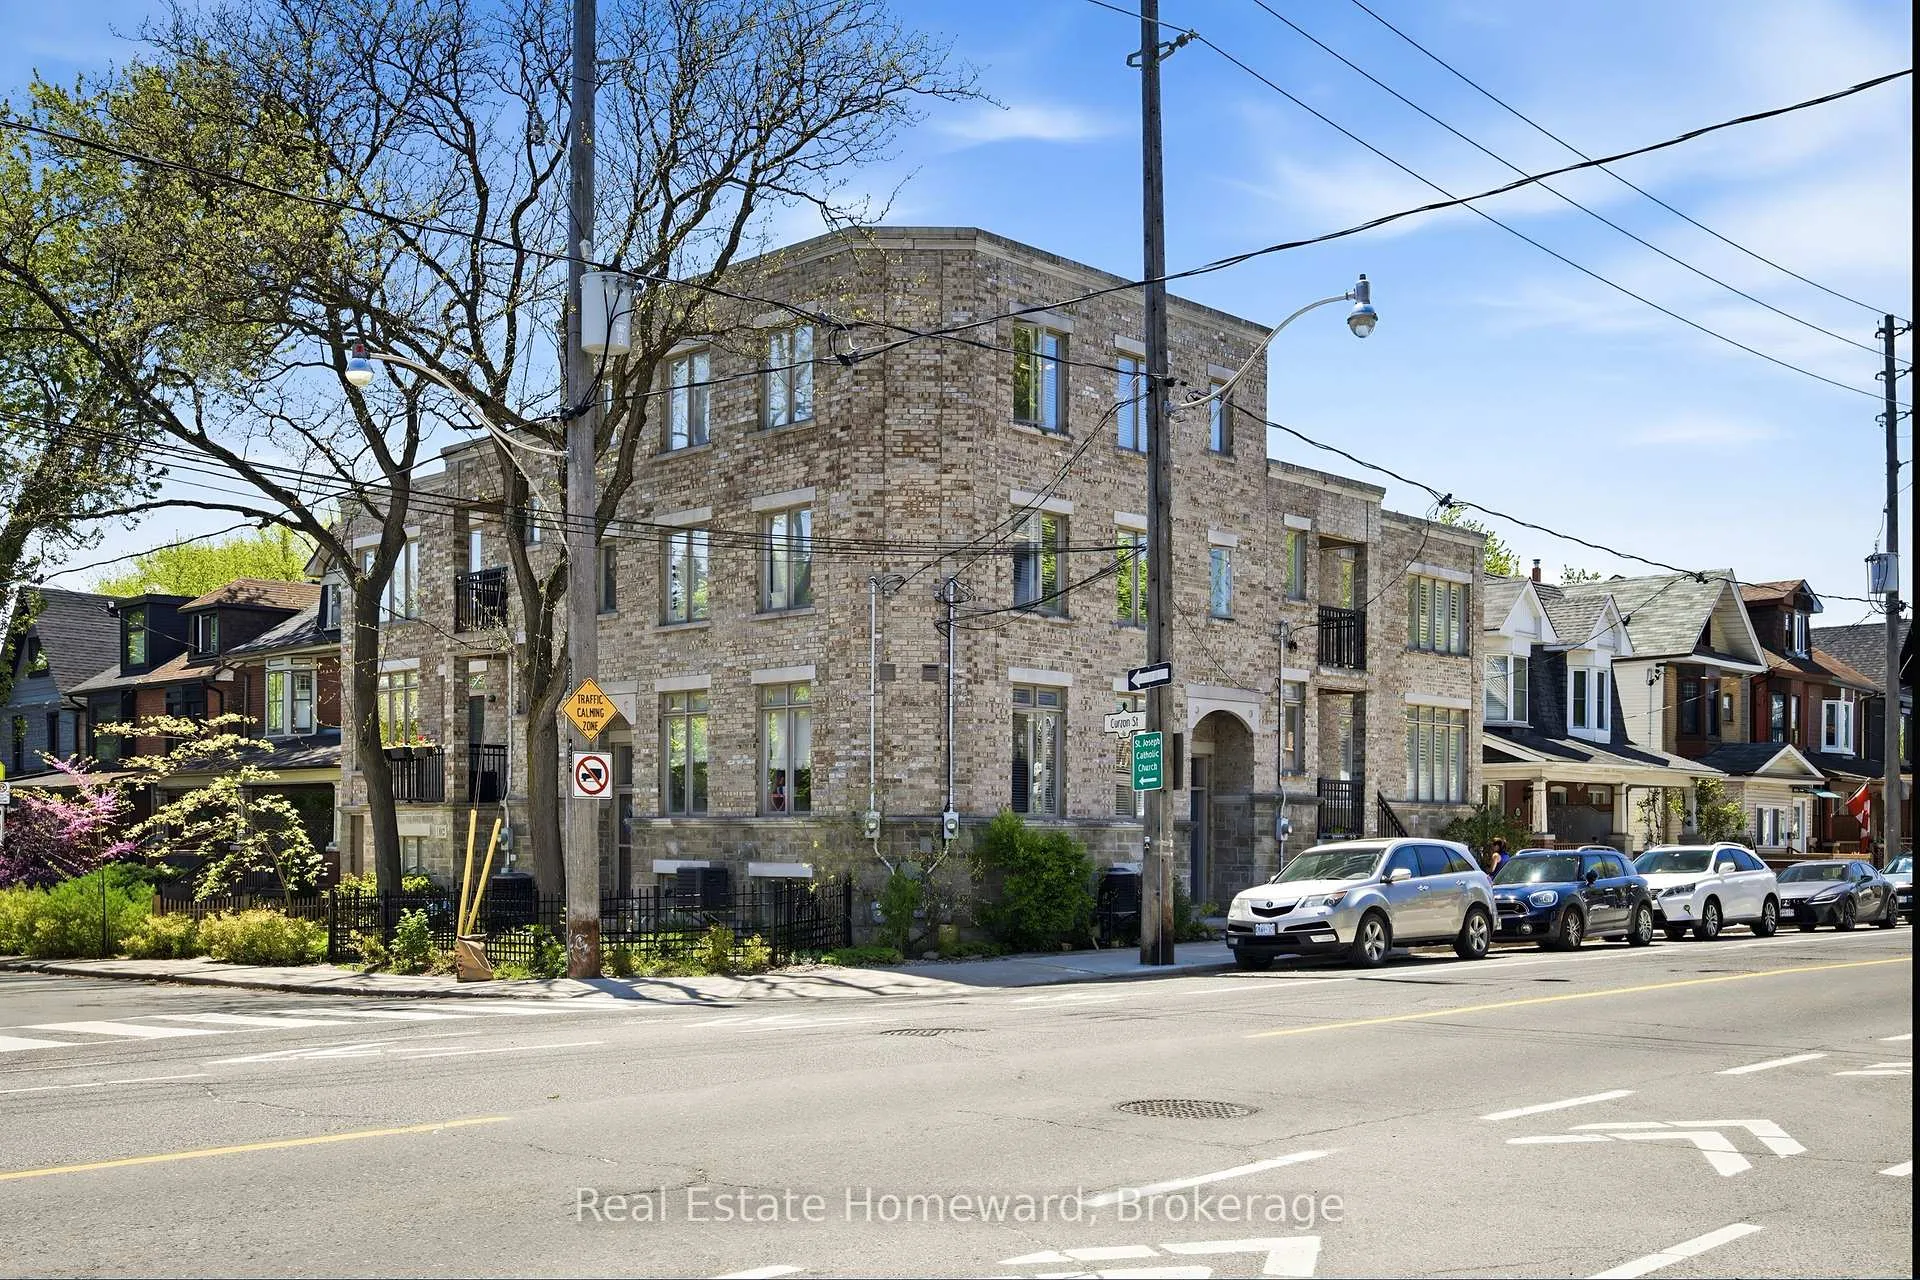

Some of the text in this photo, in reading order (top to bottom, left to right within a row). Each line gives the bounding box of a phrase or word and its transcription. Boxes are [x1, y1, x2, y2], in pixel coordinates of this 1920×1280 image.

[577, 694, 603, 704] TRAFFIC
[576, 708, 604, 718] CALMING
[582, 721, 598, 731] ZONE
[1110, 716, 1138, 728] Curzon St
[1142, 738, 1160, 748] Joseph
[1136, 750, 1159, 760] Catholic
[1138, 762, 1157, 772] Church
